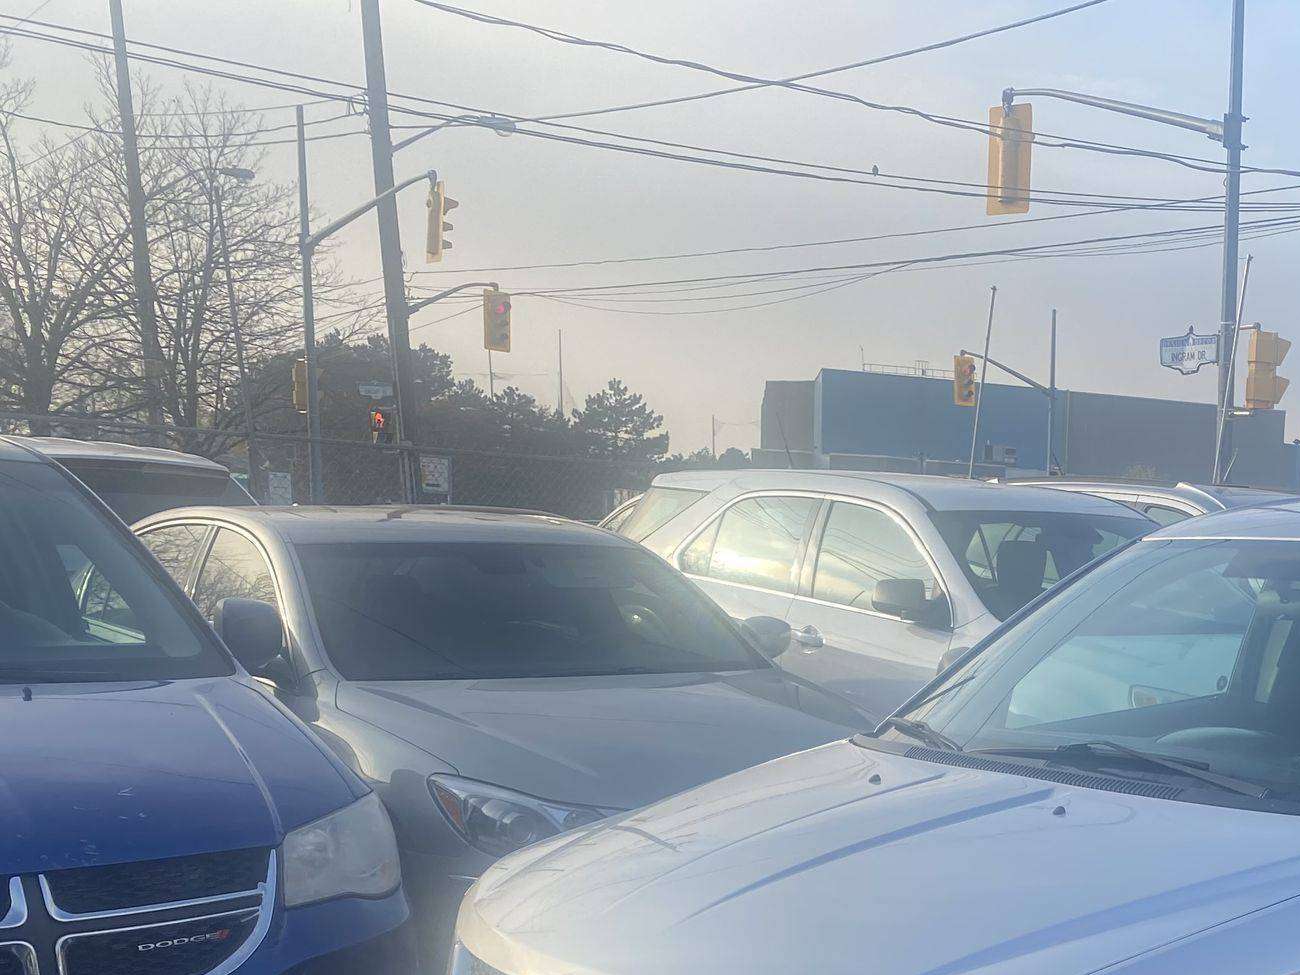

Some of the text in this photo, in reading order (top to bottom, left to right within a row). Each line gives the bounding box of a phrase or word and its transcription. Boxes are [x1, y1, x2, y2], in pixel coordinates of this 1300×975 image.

[1171, 350, 1208, 361] INGRAM DR
[137, 932, 217, 951] DODGE
